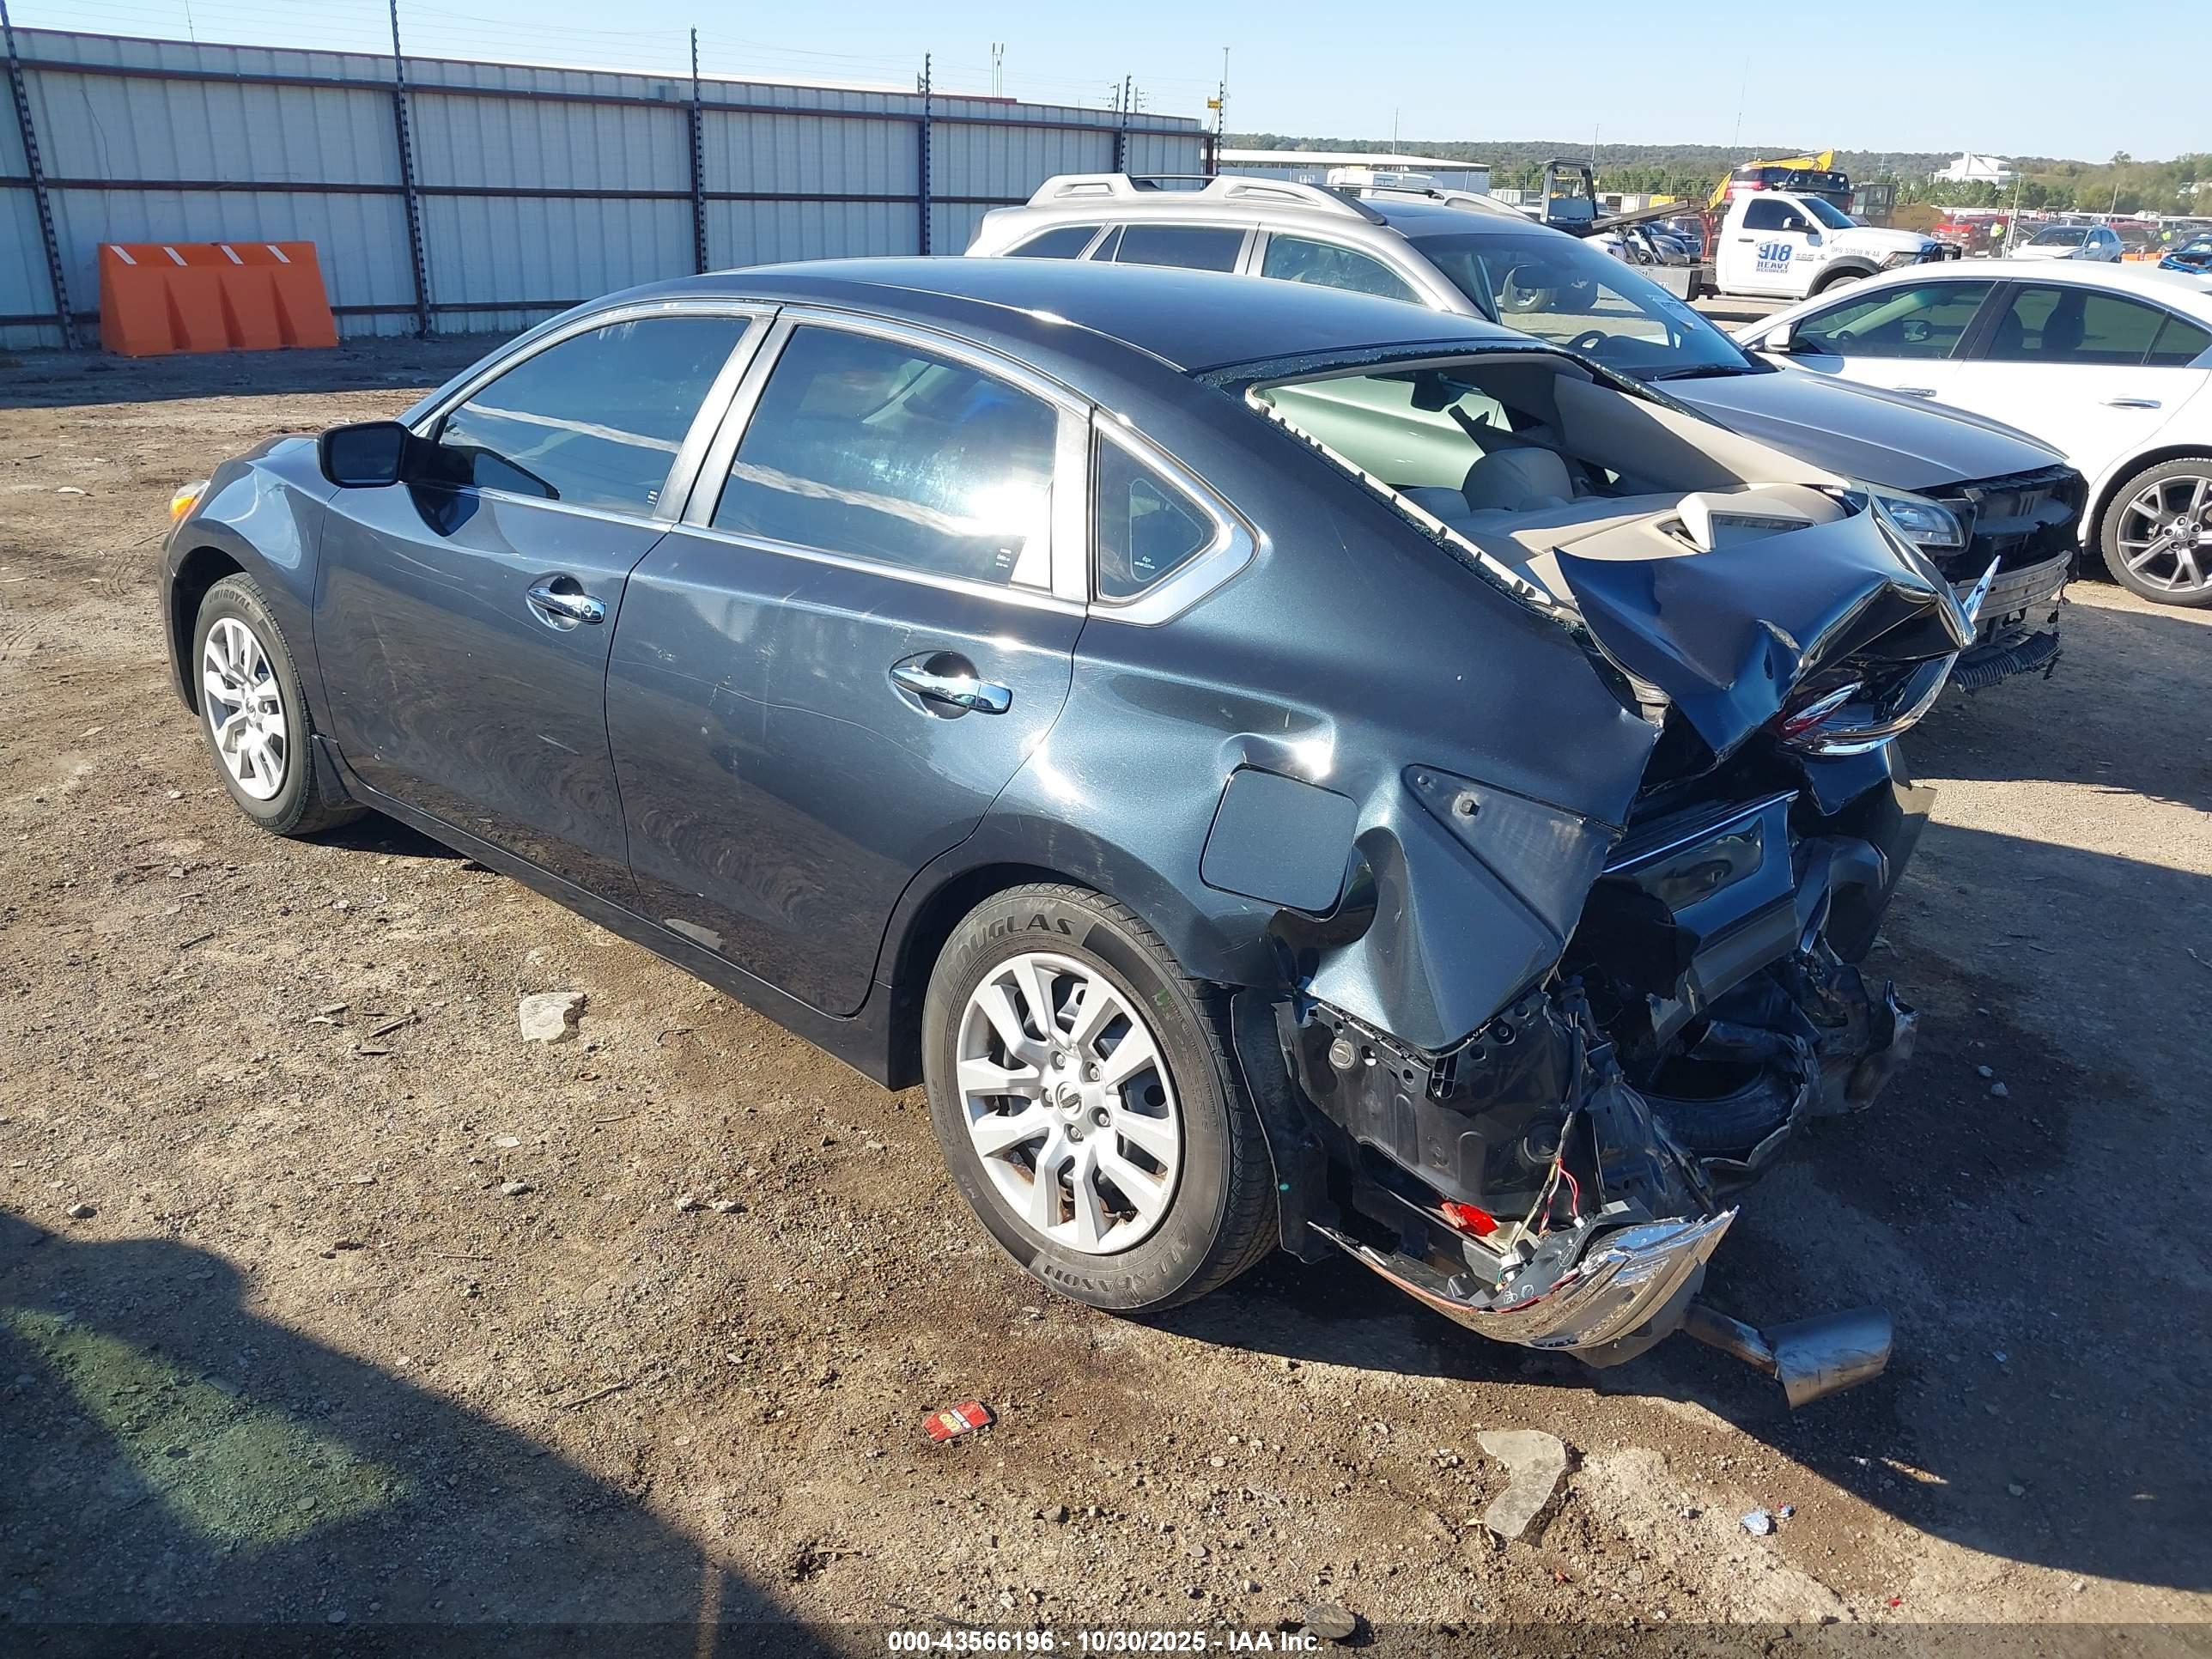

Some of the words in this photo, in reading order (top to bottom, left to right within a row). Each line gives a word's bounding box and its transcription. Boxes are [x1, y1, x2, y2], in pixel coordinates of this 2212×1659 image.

[1758, 243, 1793, 262] 918
[1757, 260, 1790, 269] HEAVY
[207, 589, 252, 611] UNIROYAL
[943, 913, 1076, 986] DOUGLAS
[1043, 1223, 1191, 1294] ALL-SEASON
